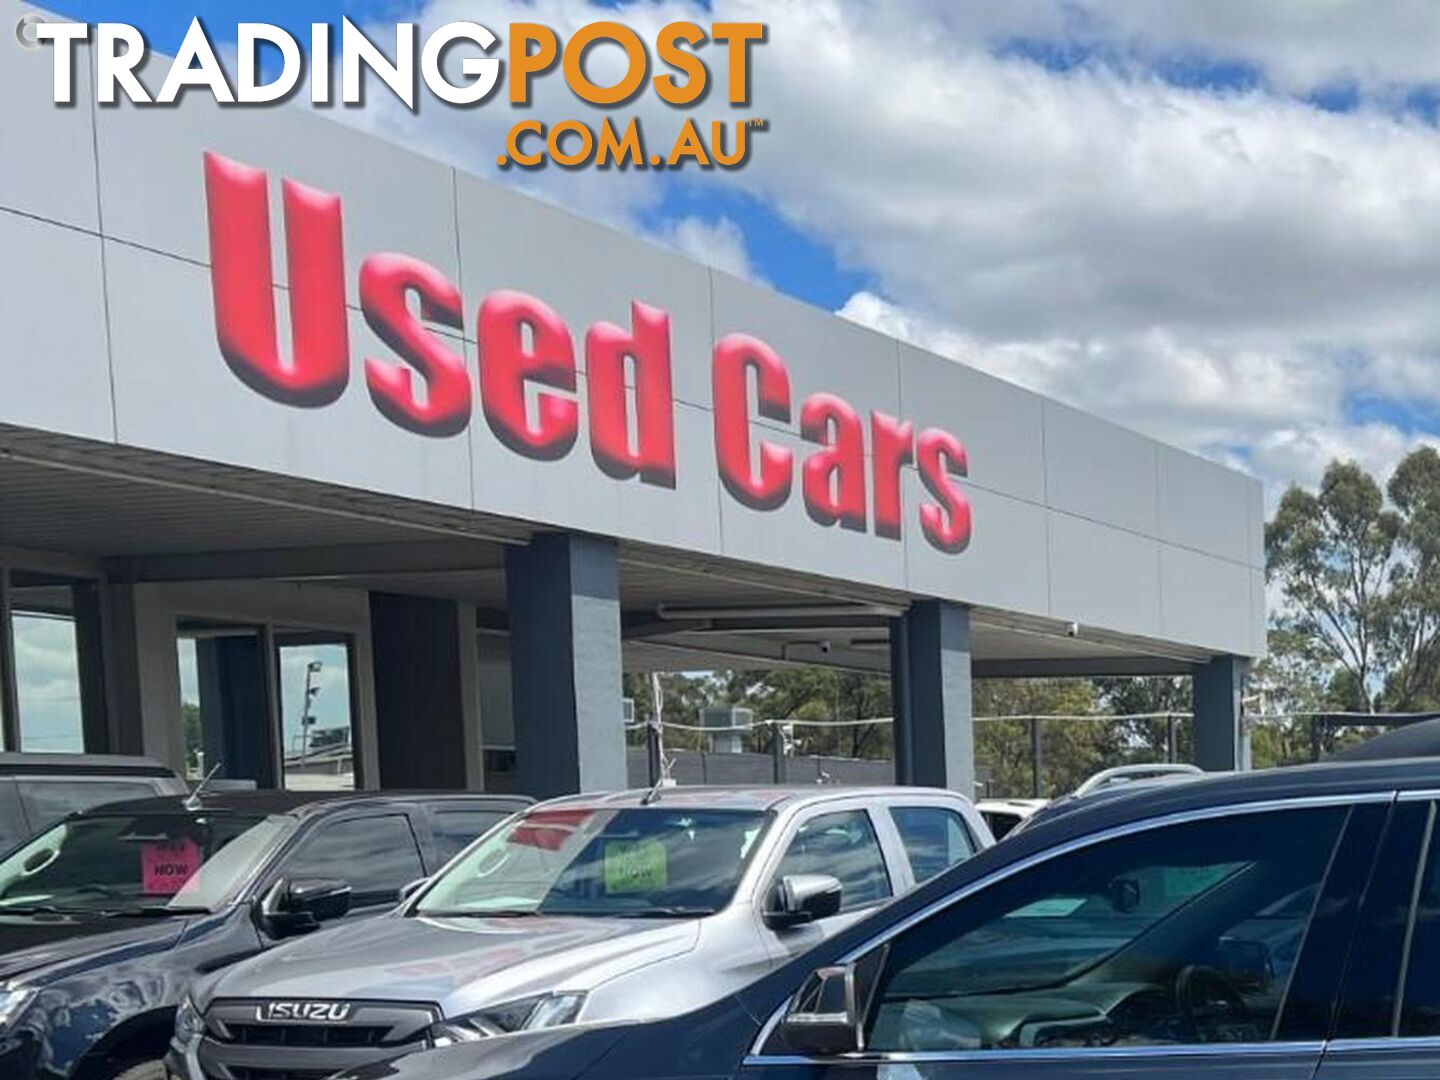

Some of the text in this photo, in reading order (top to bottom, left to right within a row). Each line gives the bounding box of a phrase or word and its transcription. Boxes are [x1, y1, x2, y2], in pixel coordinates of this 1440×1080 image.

[203, 150, 972, 555] Used Cars
[268, 1003, 350, 1020] ISUZU
